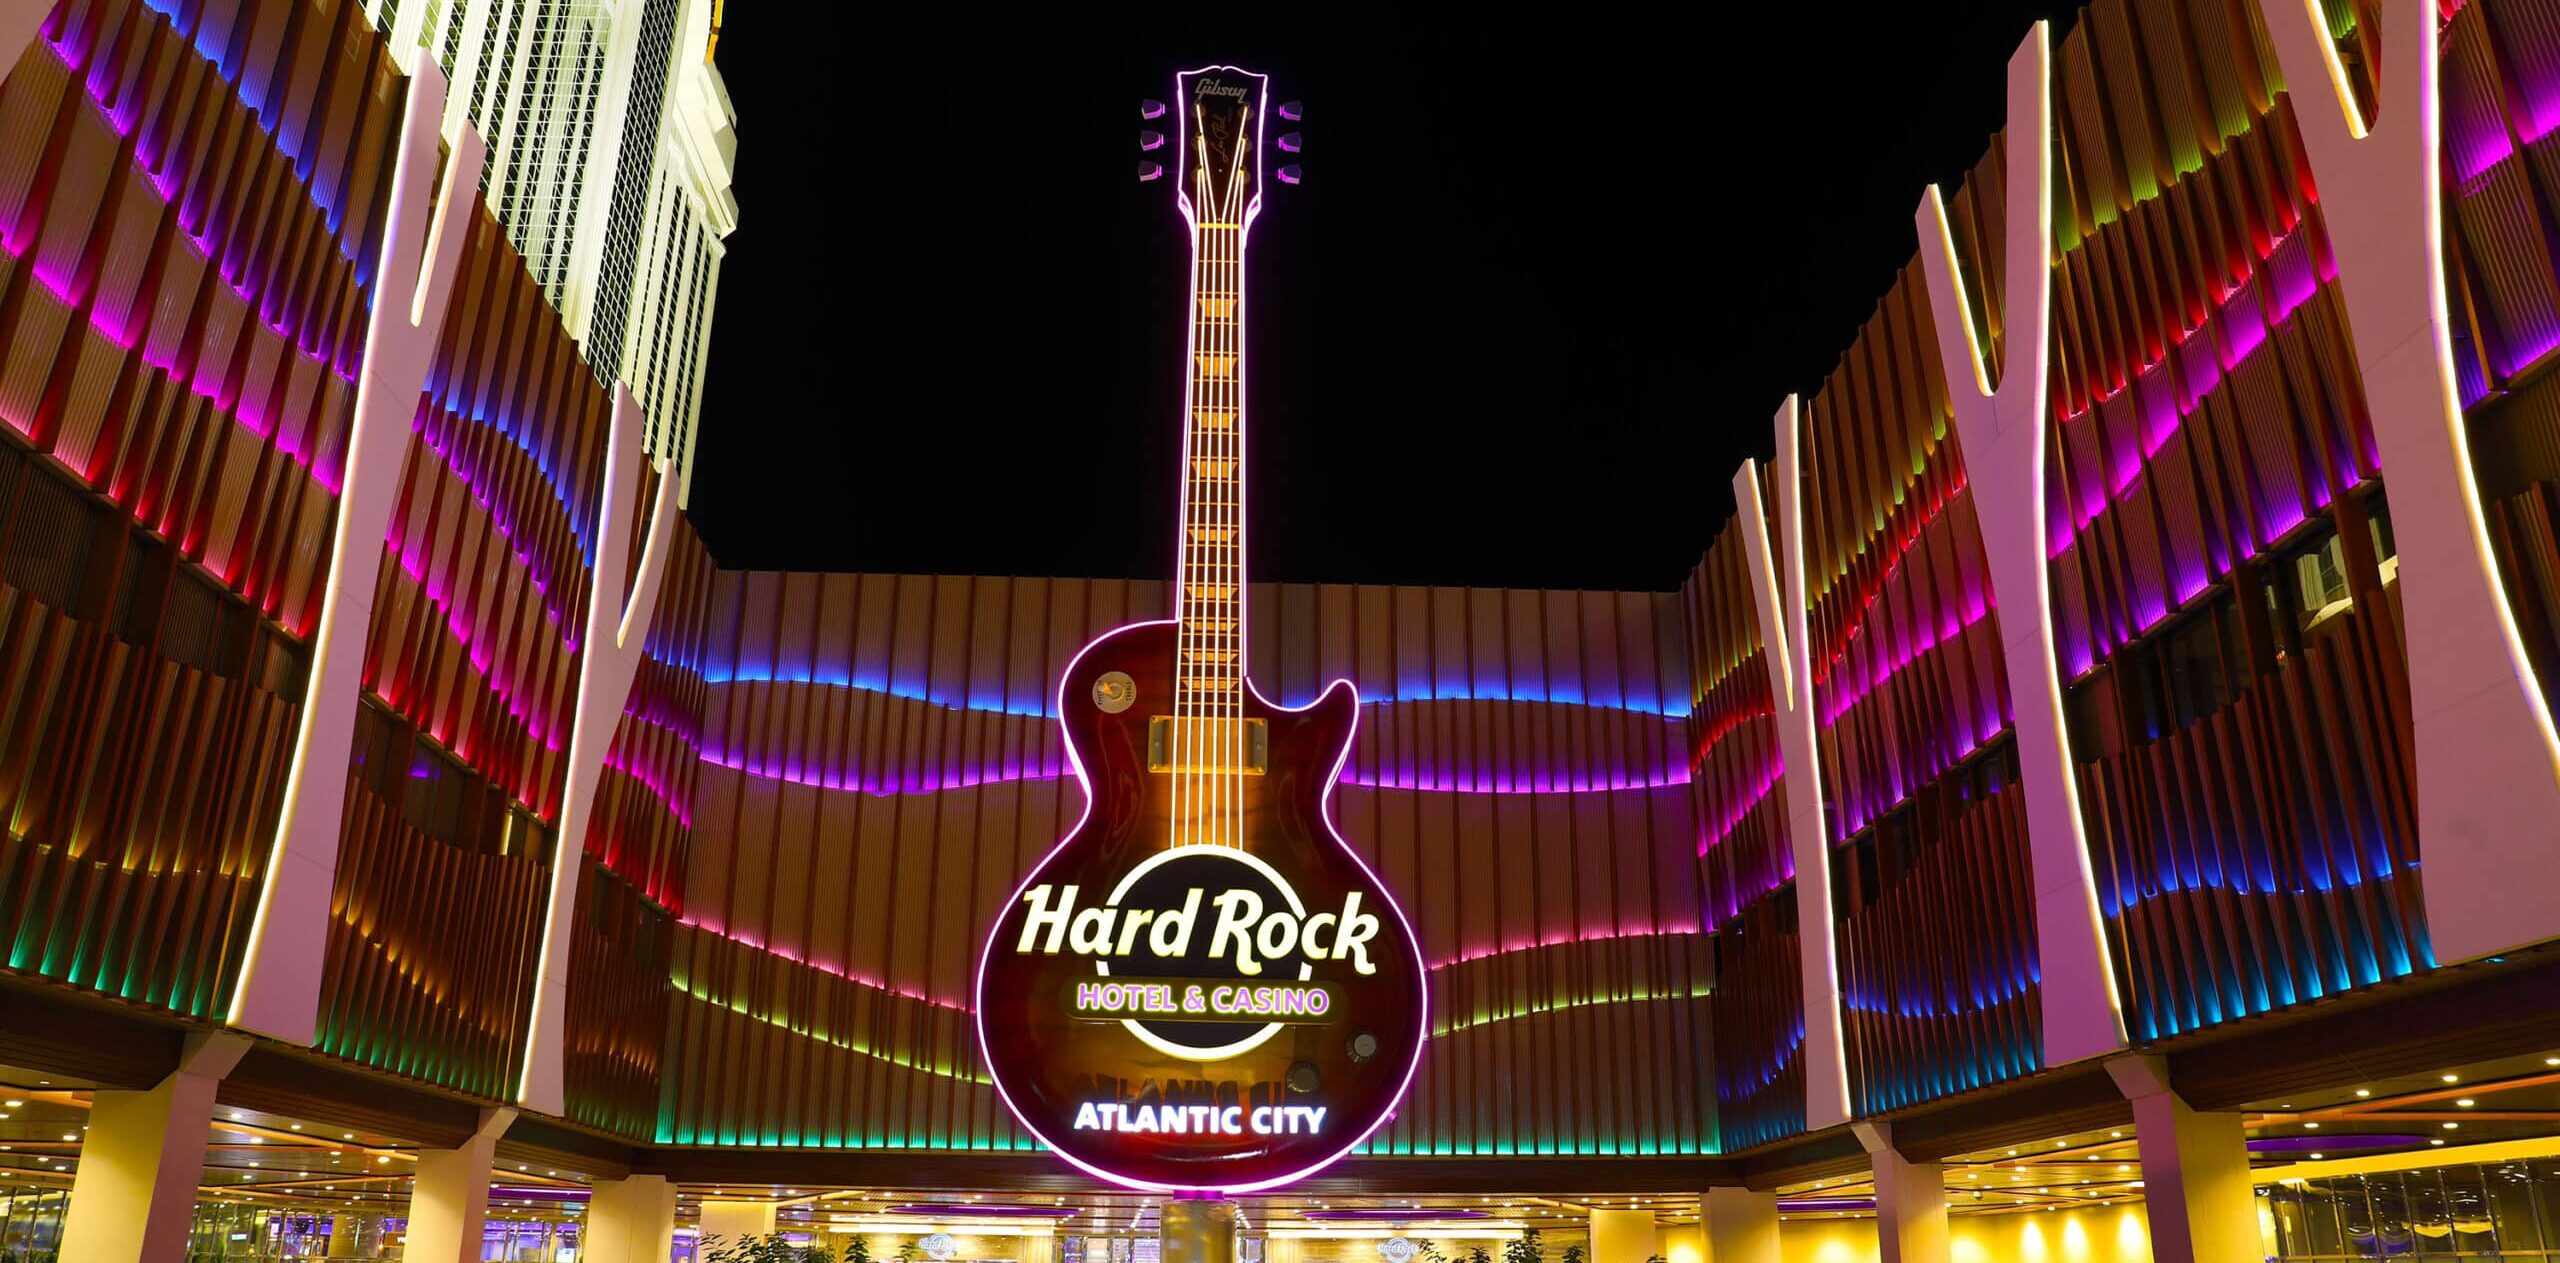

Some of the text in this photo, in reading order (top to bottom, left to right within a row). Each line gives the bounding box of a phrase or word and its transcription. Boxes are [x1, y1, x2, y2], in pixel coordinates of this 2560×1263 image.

[1195, 78, 1248, 104] Gibson
[1016, 884, 1379, 975] Hard Rock
[1077, 984, 1330, 1015] HOTEL & CASINO
[1074, 1102, 1327, 1134] ATLANTIC CITY
